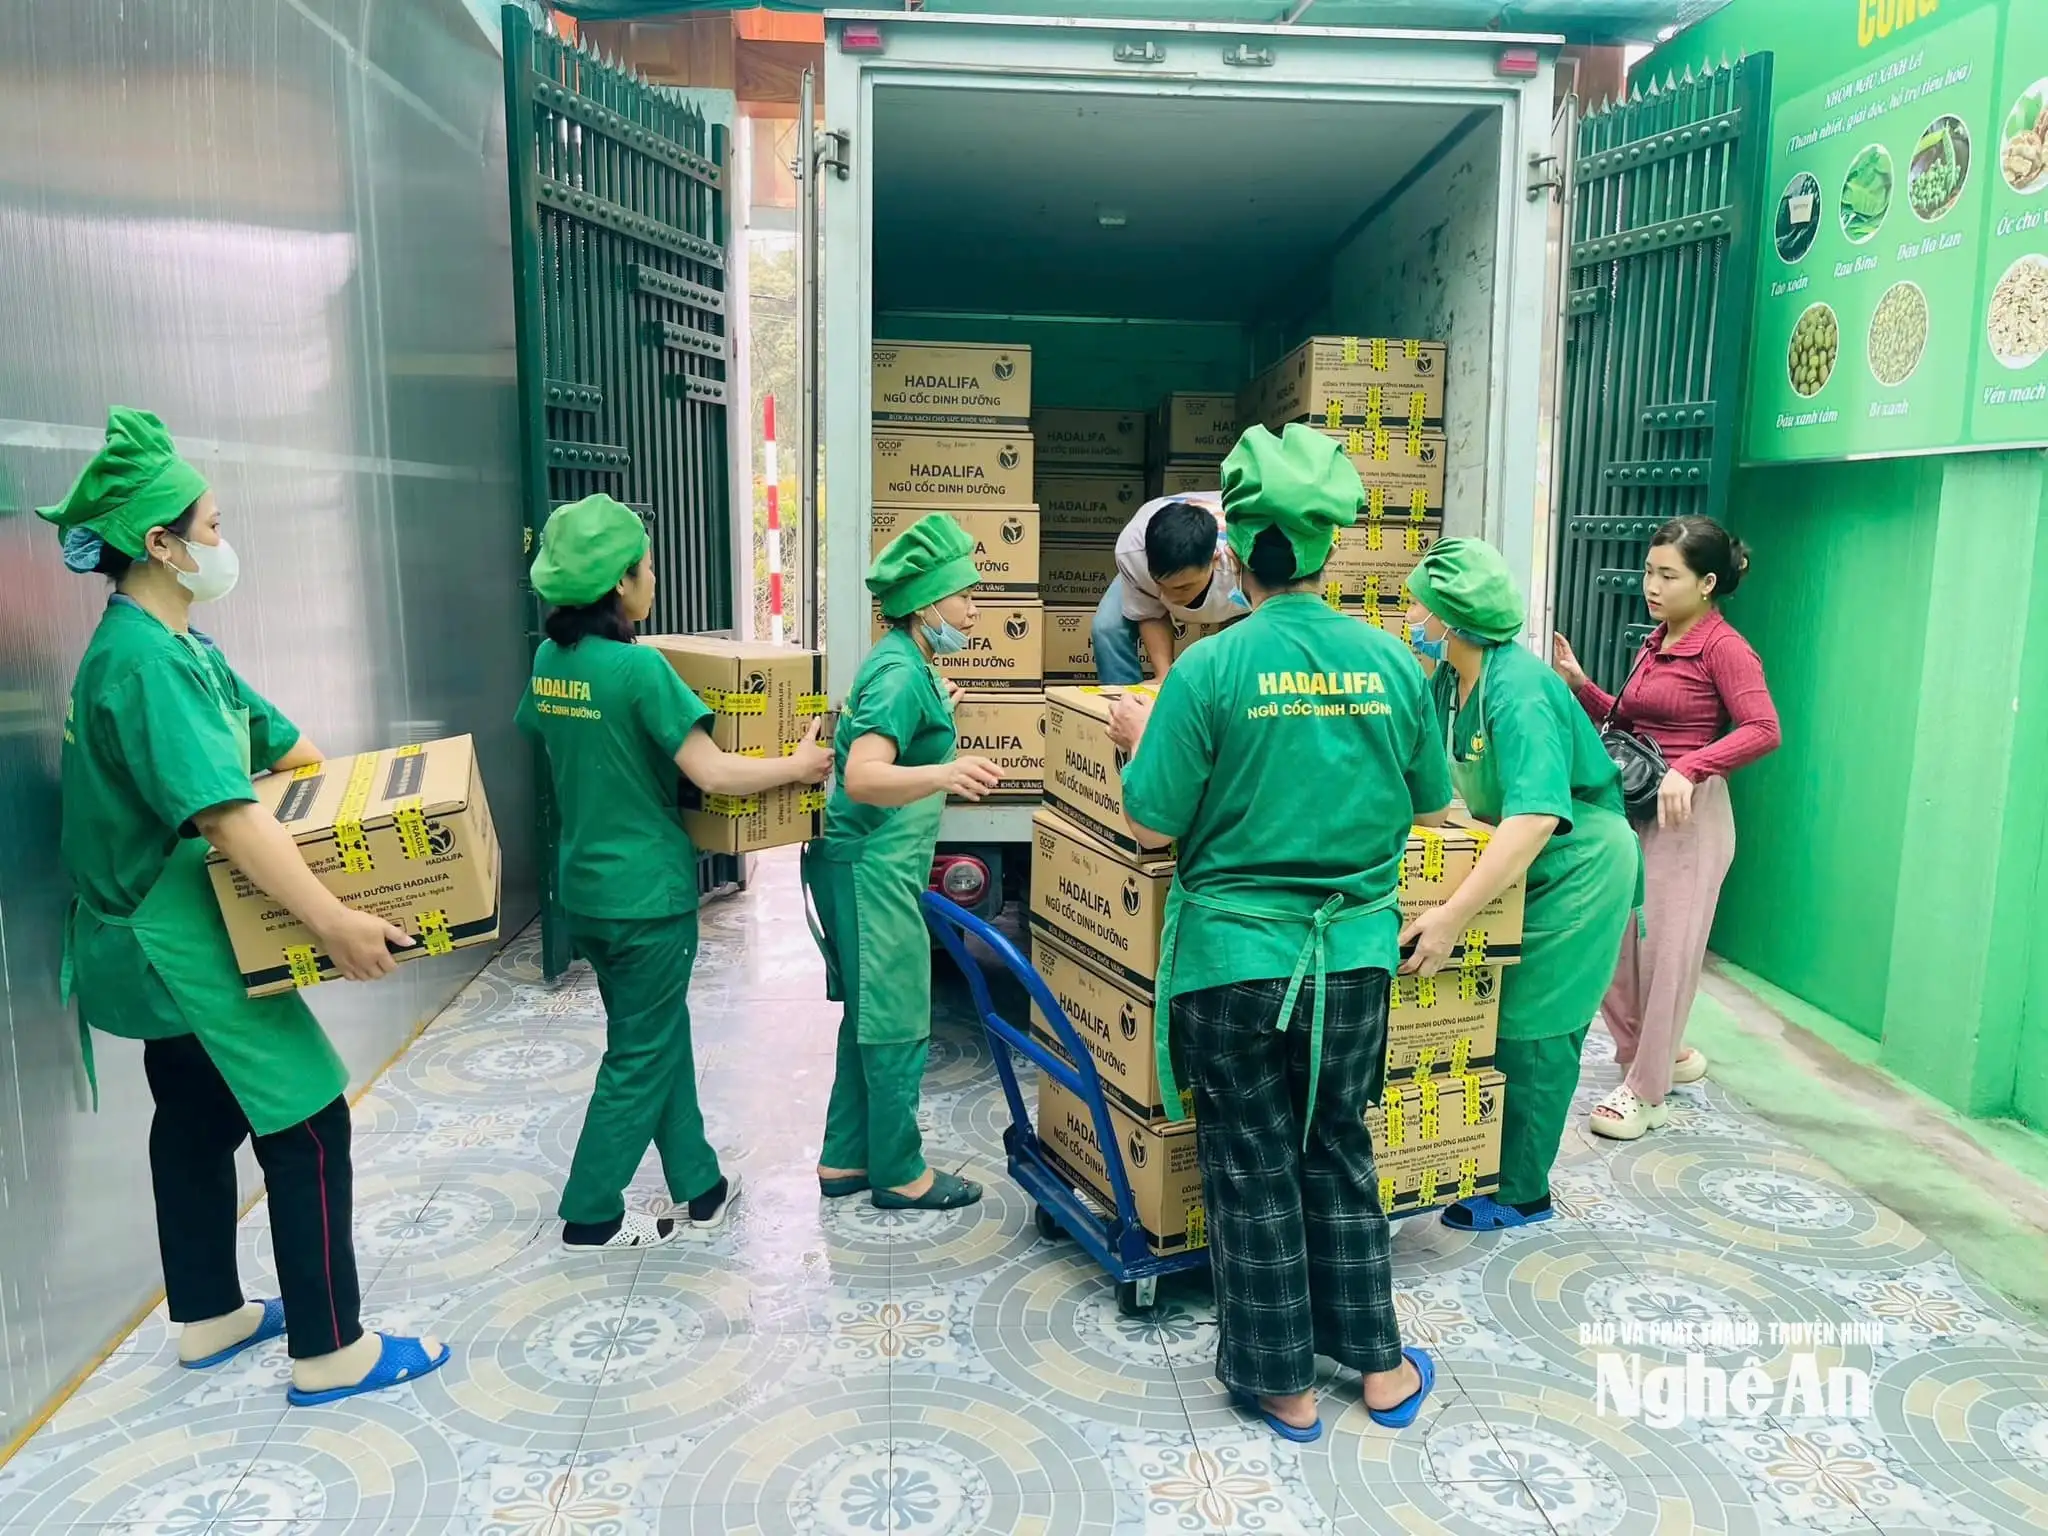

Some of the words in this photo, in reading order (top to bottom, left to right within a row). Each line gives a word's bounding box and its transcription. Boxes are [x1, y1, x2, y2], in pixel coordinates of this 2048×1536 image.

[1940, 231, 1963, 250] Lan
[1833, 260, 1851, 278] Rau
[1853, 254, 1878, 273] Bina
[904, 375, 980, 390] HADALIFA
[883, 391, 907, 404] NGŨ
[909, 392, 931, 405] CỐC
[932, 395, 959, 406] DINH
[961, 395, 1001, 407] DƯỠNG
[1882, 398, 1909, 417] xanh
[1794, 409, 1818, 427] xanh
[877, 440, 902, 450] OCOP
[910, 464, 984, 479] HADALIFA
[889, 482, 911, 493] NGŨ
[915, 480, 935, 493] CỐC
[938, 483, 963, 494] DINH
[966, 483, 1006, 495] DƯỠNG
[1048, 500, 1107, 512] HADALIFA
[975, 560, 1009, 572] ƯỠNG
[1049, 570, 1107, 582] HADALIFA
[942, 656, 970, 667] DINH
[972, 656, 1015, 668] DƯỠNG
[1068, 653, 1089, 664] NGŨ
[1257, 671, 1385, 696] HADALIFA
[1247, 701, 1278, 720] NGŨ
[1282, 698, 1312, 716] CỐC
[1314, 703, 1345, 716] DINH
[956, 736, 1023, 749] DALIFA
[1065, 748, 1107, 785] HADALIFA
[1055, 769, 1066, 787] NGŨ
[1067, 777, 1078, 795] CỐC
[1078, 782, 1094, 802] DINH
[1094, 789, 1120, 815] DƯỠNG
[411, 820, 427, 858] FRAGILE
[425, 852, 464, 867] HADALIFA
[363, 883, 402, 898] DƯỠNG
[402, 872, 450, 890] HADALIFA
[1058, 875, 1112, 920] HADALIFA
[1418, 899, 1438, 907] DINH
[260, 907, 290, 921] CÔNG
[1045, 895, 1061, 914] NGŨ
[1061, 902, 1077, 922] CỐC
[1077, 914, 1096, 934] DINH
[1097, 924, 1128, 952] DƯỠNG
[1058, 992, 1111, 1042] HADALIFA
[1396, 1023, 1414, 1032] TNHH
[1416, 1021, 1432, 1030] DINH
[1433, 1016, 1456, 1028] DƯỠNG
[1457, 1013, 1485, 1024] HADALIFA
[1096, 1047, 1127, 1076] DƯỠNG
[1053, 1125, 1069, 1148] NGŨ
[1069, 1138, 1084, 1161] CỐC
[1085, 1152, 1104, 1177] DINH
[1399, 1147, 1416, 1156] TNHH
[1417, 1143, 1432, 1152] DINH
[1433, 1137, 1457, 1148] DƯỠNG
[1457, 1133, 1486, 1144] HADALIFA
